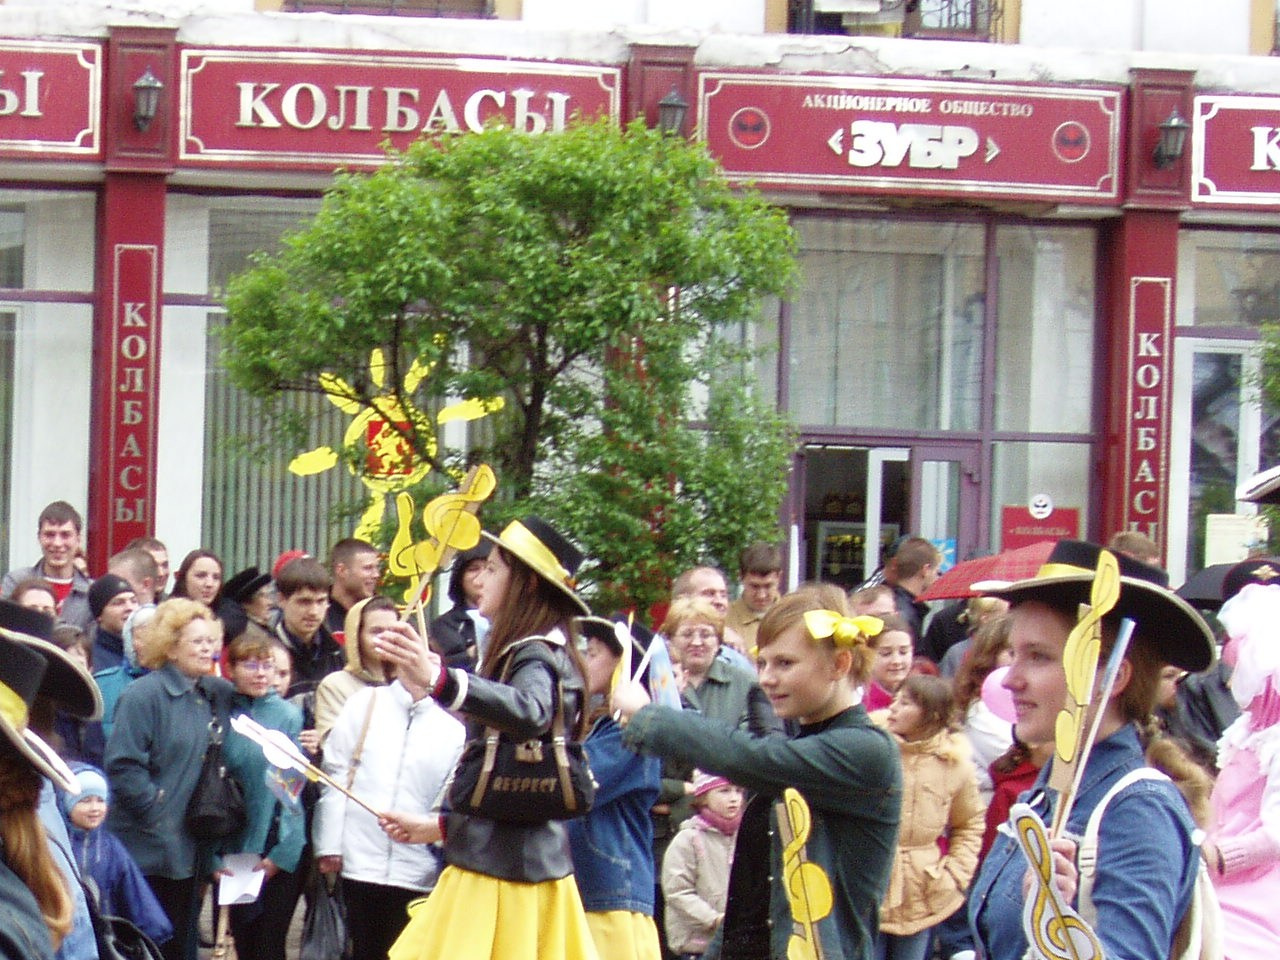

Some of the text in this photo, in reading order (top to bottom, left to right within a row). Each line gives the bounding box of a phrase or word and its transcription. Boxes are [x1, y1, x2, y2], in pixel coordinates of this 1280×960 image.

[235, 82, 571, 136] КОЛБАСЫ
[802, 94, 1034, 117] АКЦИОНЕРНОЕ ОБЩЕСТВО
[113, 302, 148, 523] КОЛБАСЫ
